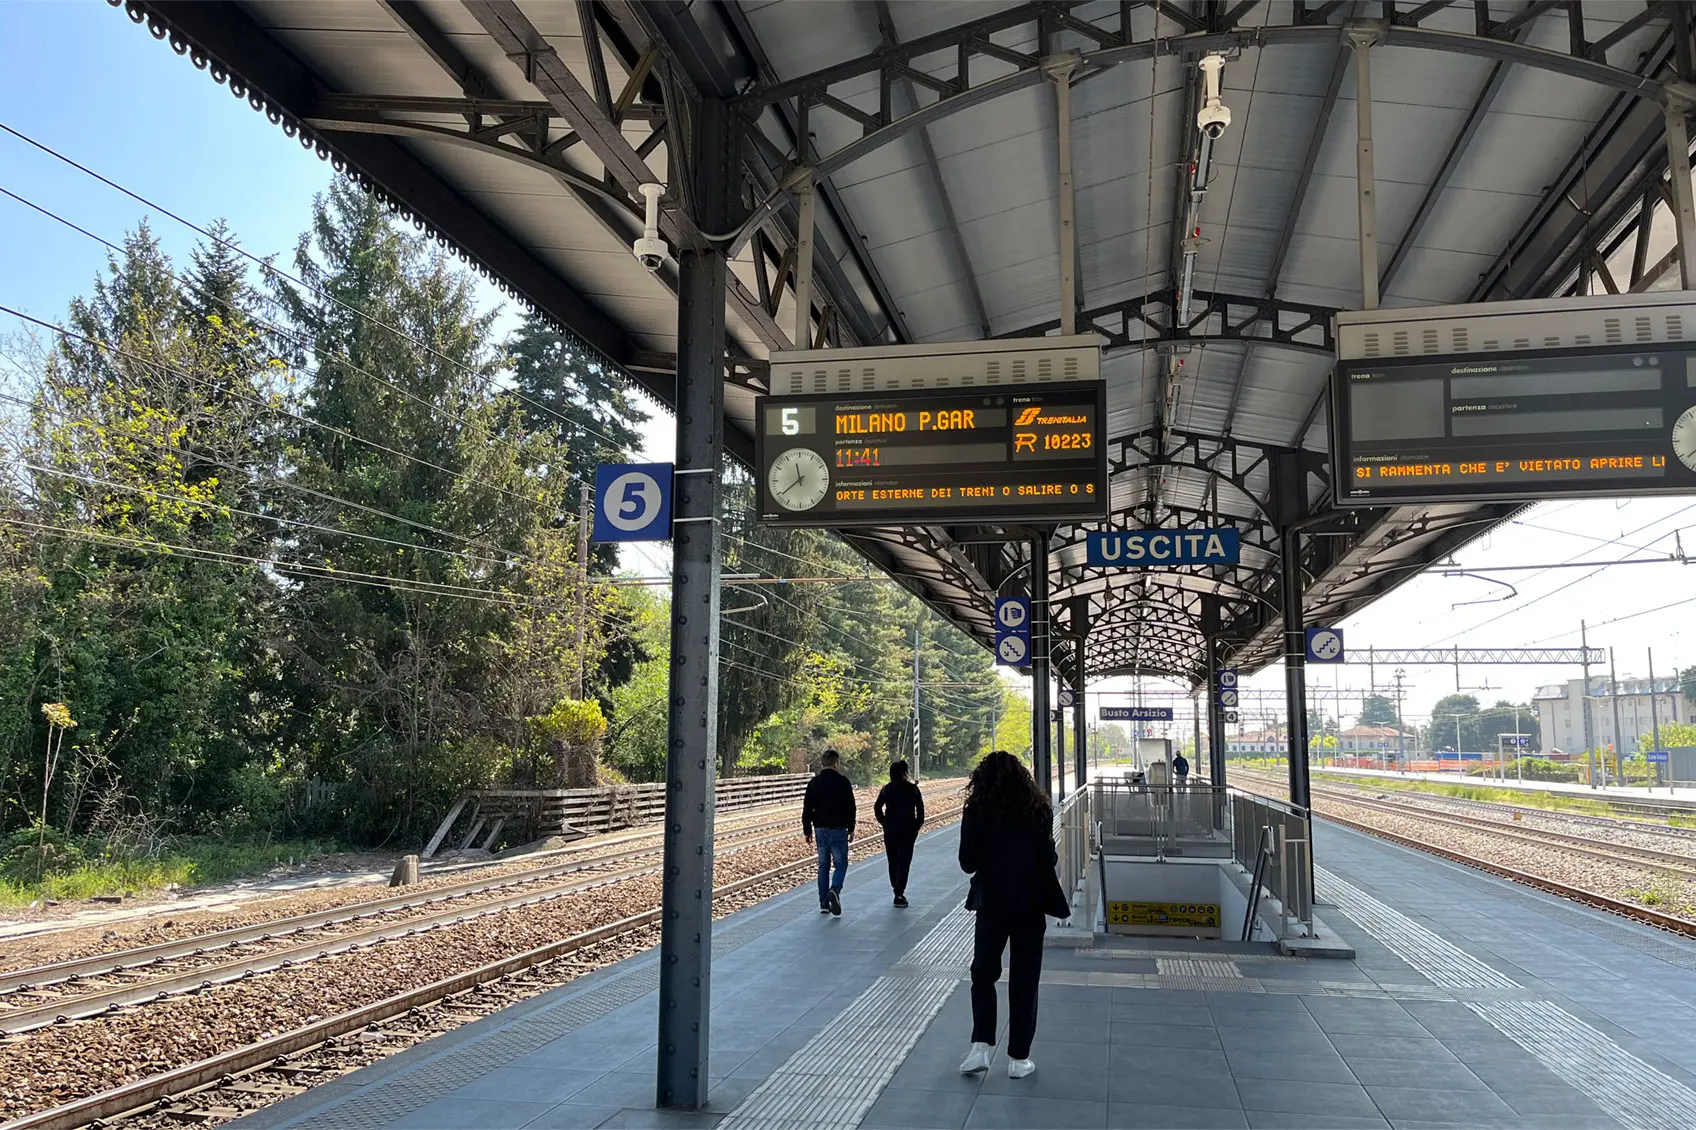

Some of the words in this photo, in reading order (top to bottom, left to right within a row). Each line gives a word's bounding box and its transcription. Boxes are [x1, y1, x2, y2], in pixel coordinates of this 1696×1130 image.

[1451, 365, 1497, 374] destinazione
[834, 403, 872, 411] destinazione
[1452, 403, 1487, 413] partenza
[781, 407, 800, 436] 5
[835, 411, 906, 435] MILANO
[919, 409, 976, 432] P.GAR
[1036, 415, 1088, 426] TRENITALIA
[835, 438, 863, 446] partenza
[1014, 432, 1038, 453] R
[1044, 432, 1092, 450] 10223
[836, 447, 881, 468] 11:41
[1353, 454, 1398, 462] informazioni
[1356, 466, 1371, 478] SI
[1380, 464, 1451, 477] RAMMENTA
[1459, 462, 1487, 474] CHE
[1519, 459, 1581, 472] VIETATO
[1590, 456, 1643, 469] APRIRE
[835, 479, 873, 487] informazioni
[836, 490, 865, 501] ORTE
[872, 488, 925, 500] ESTERNE
[931, 488, 952, 498] DEI
[960, 486, 995, 497] TRENI
[1002, 486, 1011, 496] O
[1017, 484, 1063, 495] SALIRE
[1070, 484, 1079, 494] O
[1086, 483, 1095, 494] S
[618, 482, 647, 521] 5
[1101, 534, 1226, 561] USCITA
[1101, 708, 1129, 717] Busto
[1132, 708, 1167, 717] Arsizio
